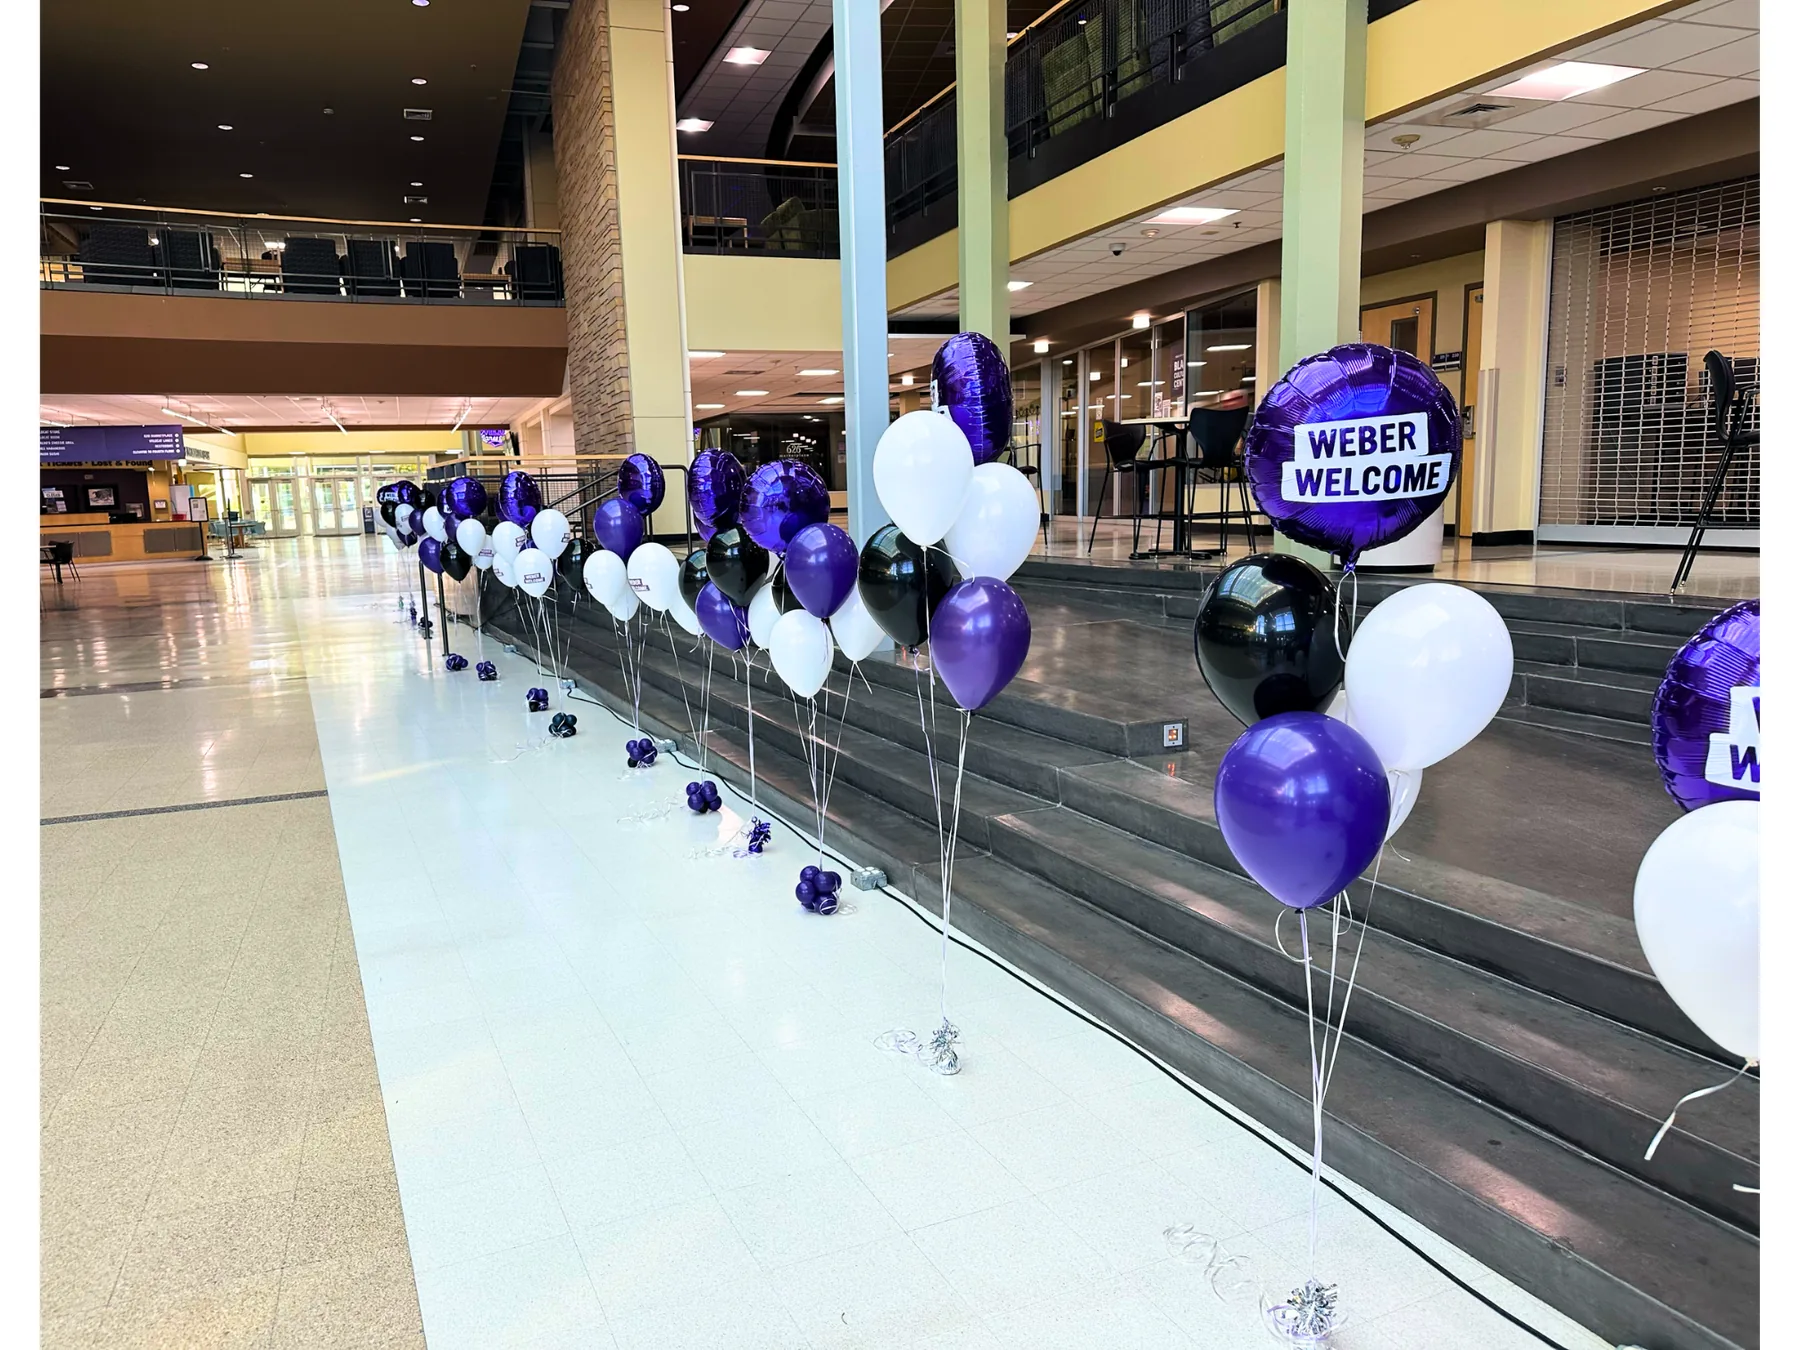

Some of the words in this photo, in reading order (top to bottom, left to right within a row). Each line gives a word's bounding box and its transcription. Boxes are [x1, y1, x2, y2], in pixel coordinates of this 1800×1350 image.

[787, 444, 801, 453] 626
[1308, 421, 1416, 459] WEBER
[1295, 461, 1442, 497] WELCOME
